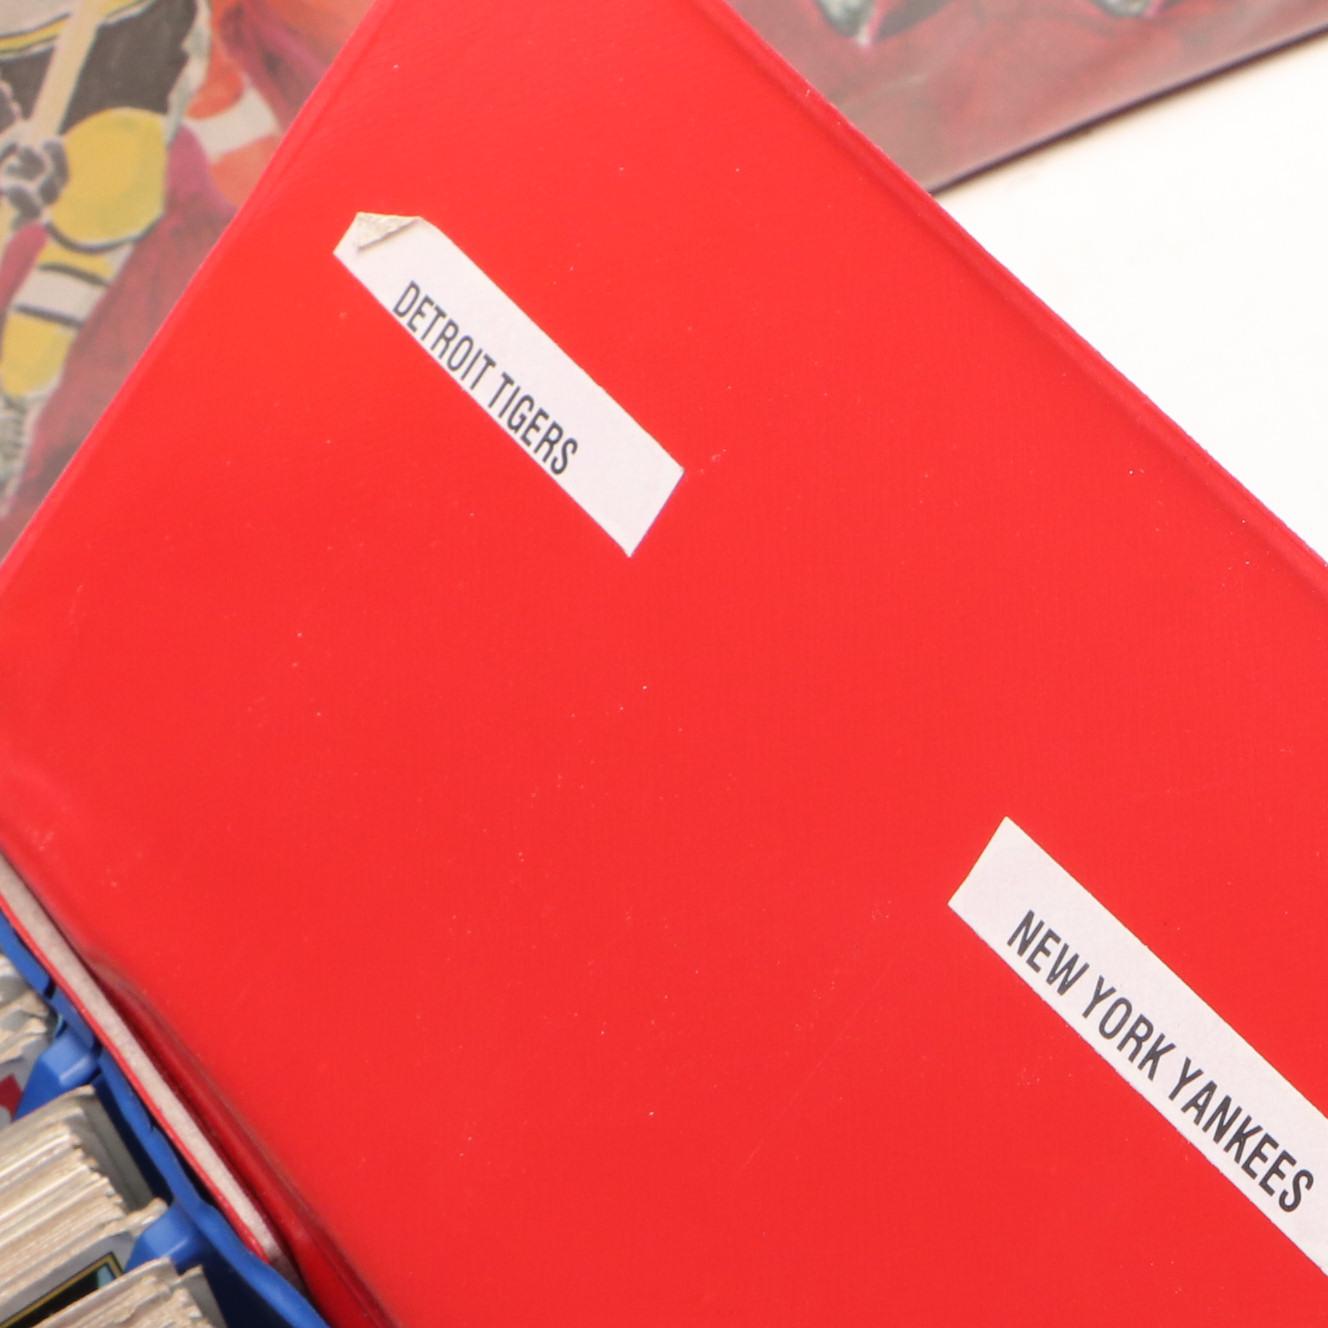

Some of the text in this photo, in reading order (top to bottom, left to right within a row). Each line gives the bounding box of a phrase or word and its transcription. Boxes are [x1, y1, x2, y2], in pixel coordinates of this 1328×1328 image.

[392, 280, 579, 476] DETROIT TIGERS
[1006, 909, 1315, 1214] NEW YORK YANKEES
